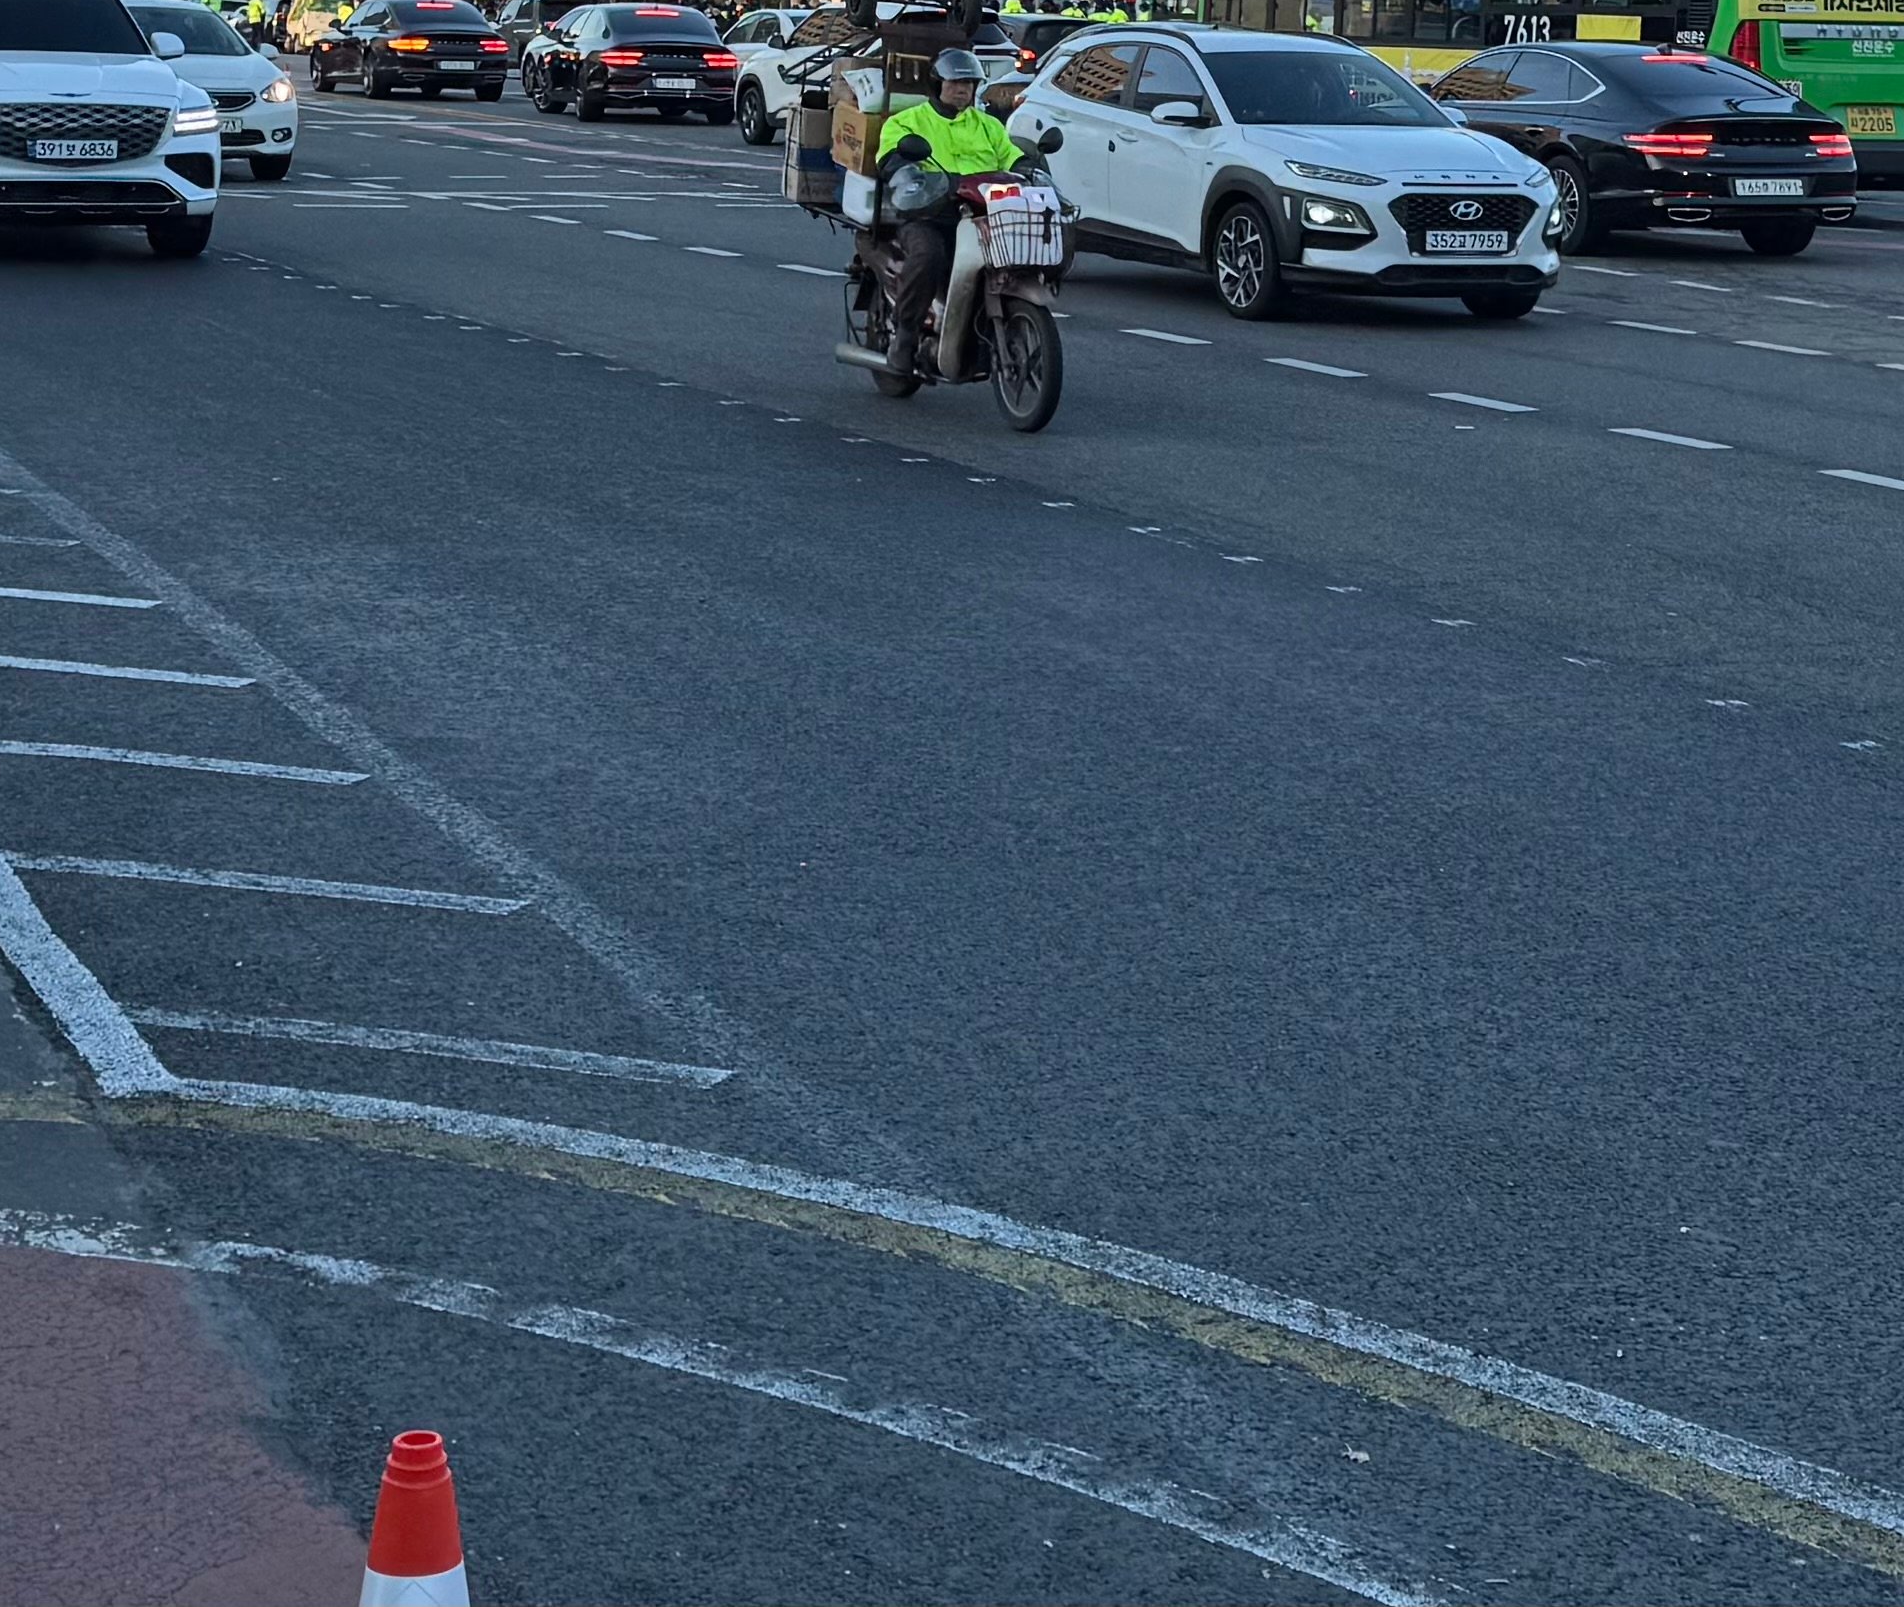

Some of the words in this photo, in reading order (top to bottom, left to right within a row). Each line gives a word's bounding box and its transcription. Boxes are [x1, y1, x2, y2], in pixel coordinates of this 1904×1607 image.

[1503, 14, 1551, 45] 7613
[1852, 40, 1895, 54] 신진운수
[1860, 118, 1894, 132] 2205
[79, 142, 115, 157] 6836
[1469, 233, 1504, 249] 7959
